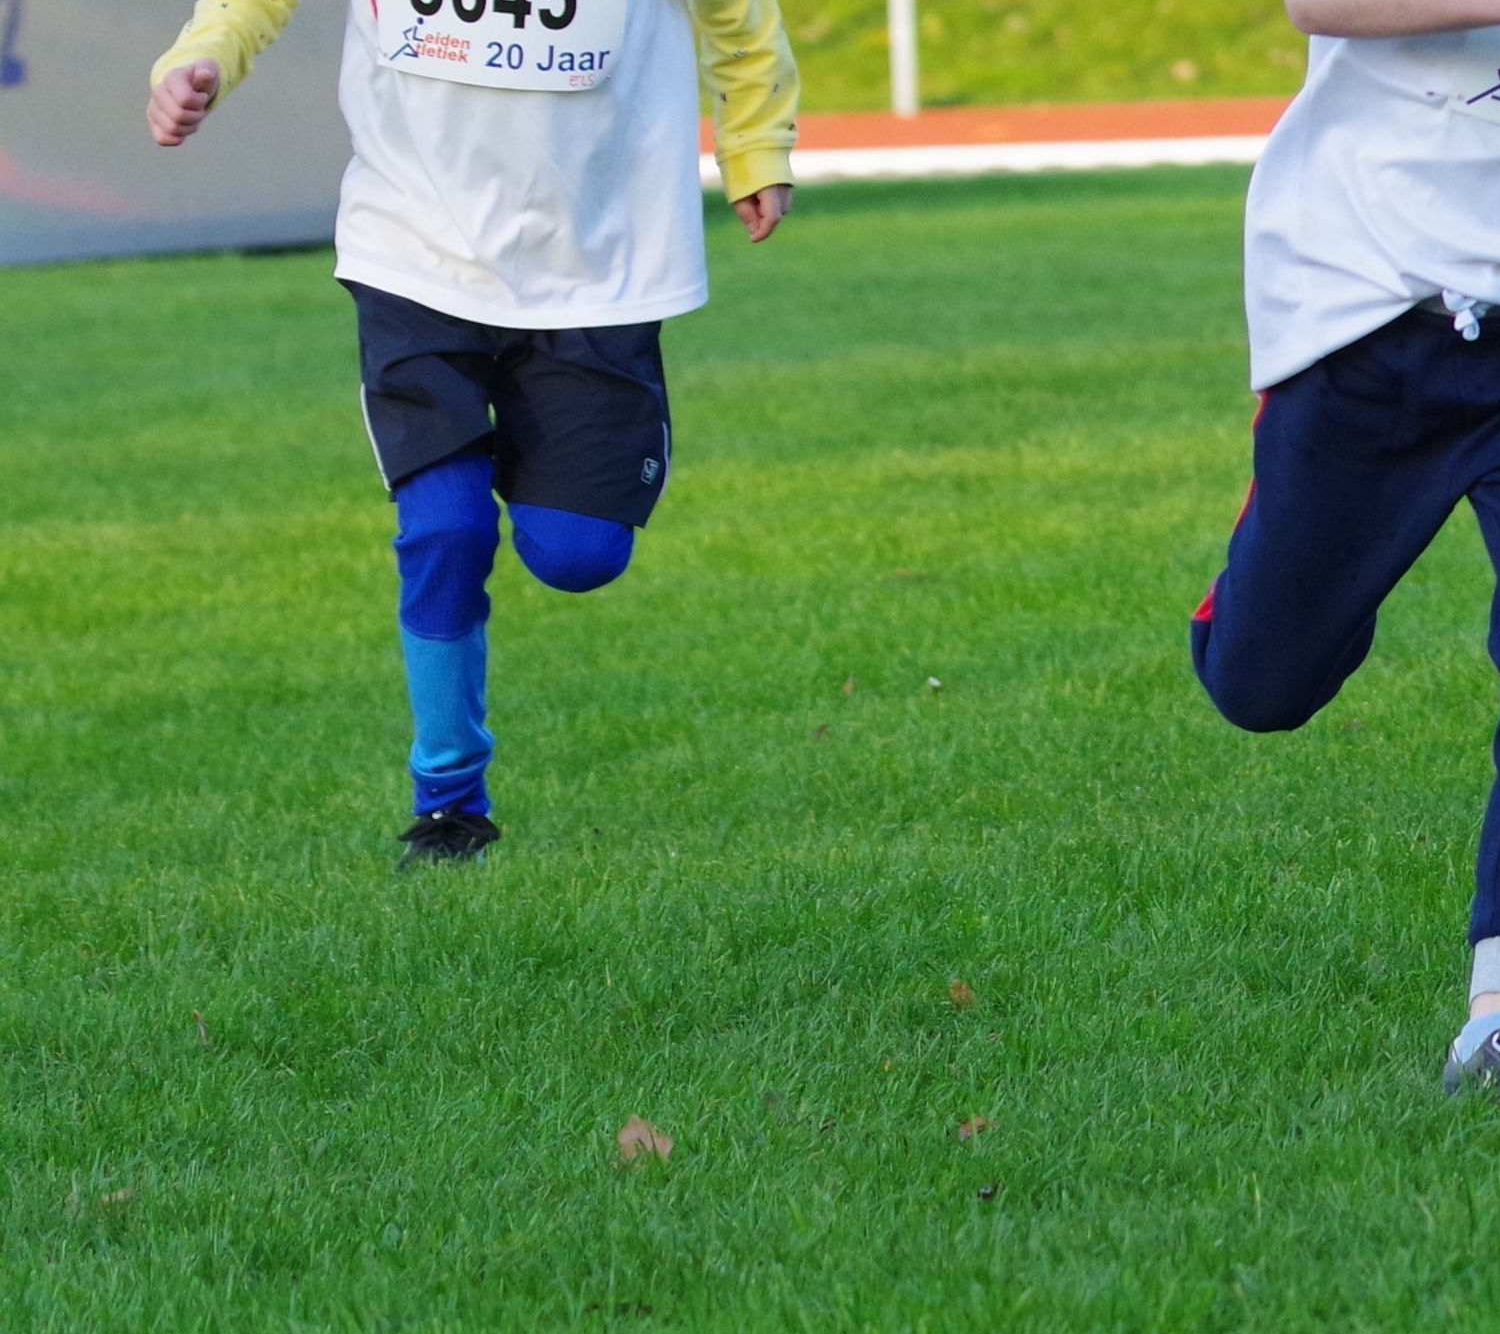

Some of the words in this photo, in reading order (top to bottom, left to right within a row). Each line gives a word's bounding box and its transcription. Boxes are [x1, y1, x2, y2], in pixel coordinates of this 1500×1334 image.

[412, 26, 471, 50] Leiden
[485, 41, 524, 70] 20
[536, 45, 611, 72] Jaar
